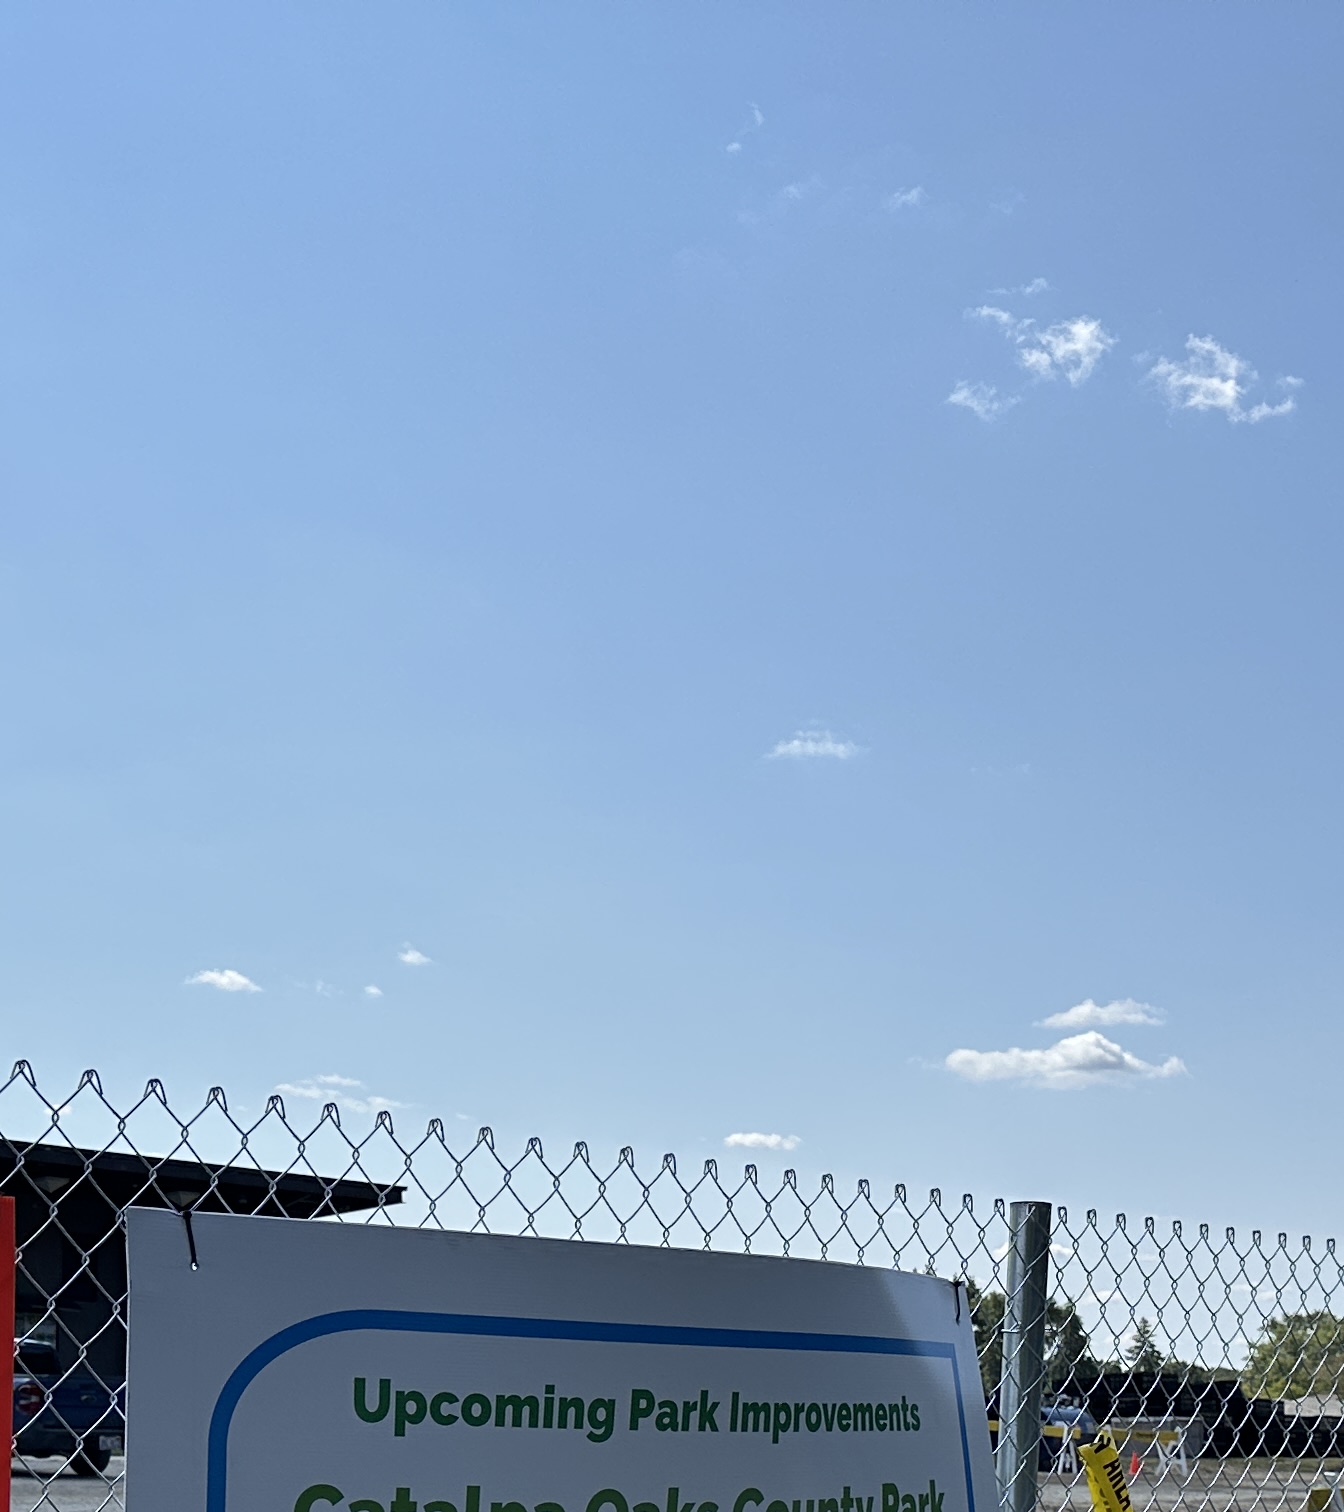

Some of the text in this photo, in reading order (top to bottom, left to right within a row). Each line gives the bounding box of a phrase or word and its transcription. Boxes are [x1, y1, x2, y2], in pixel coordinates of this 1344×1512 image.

[354, 1377, 920, 1444] Upcoming Park Improvements
